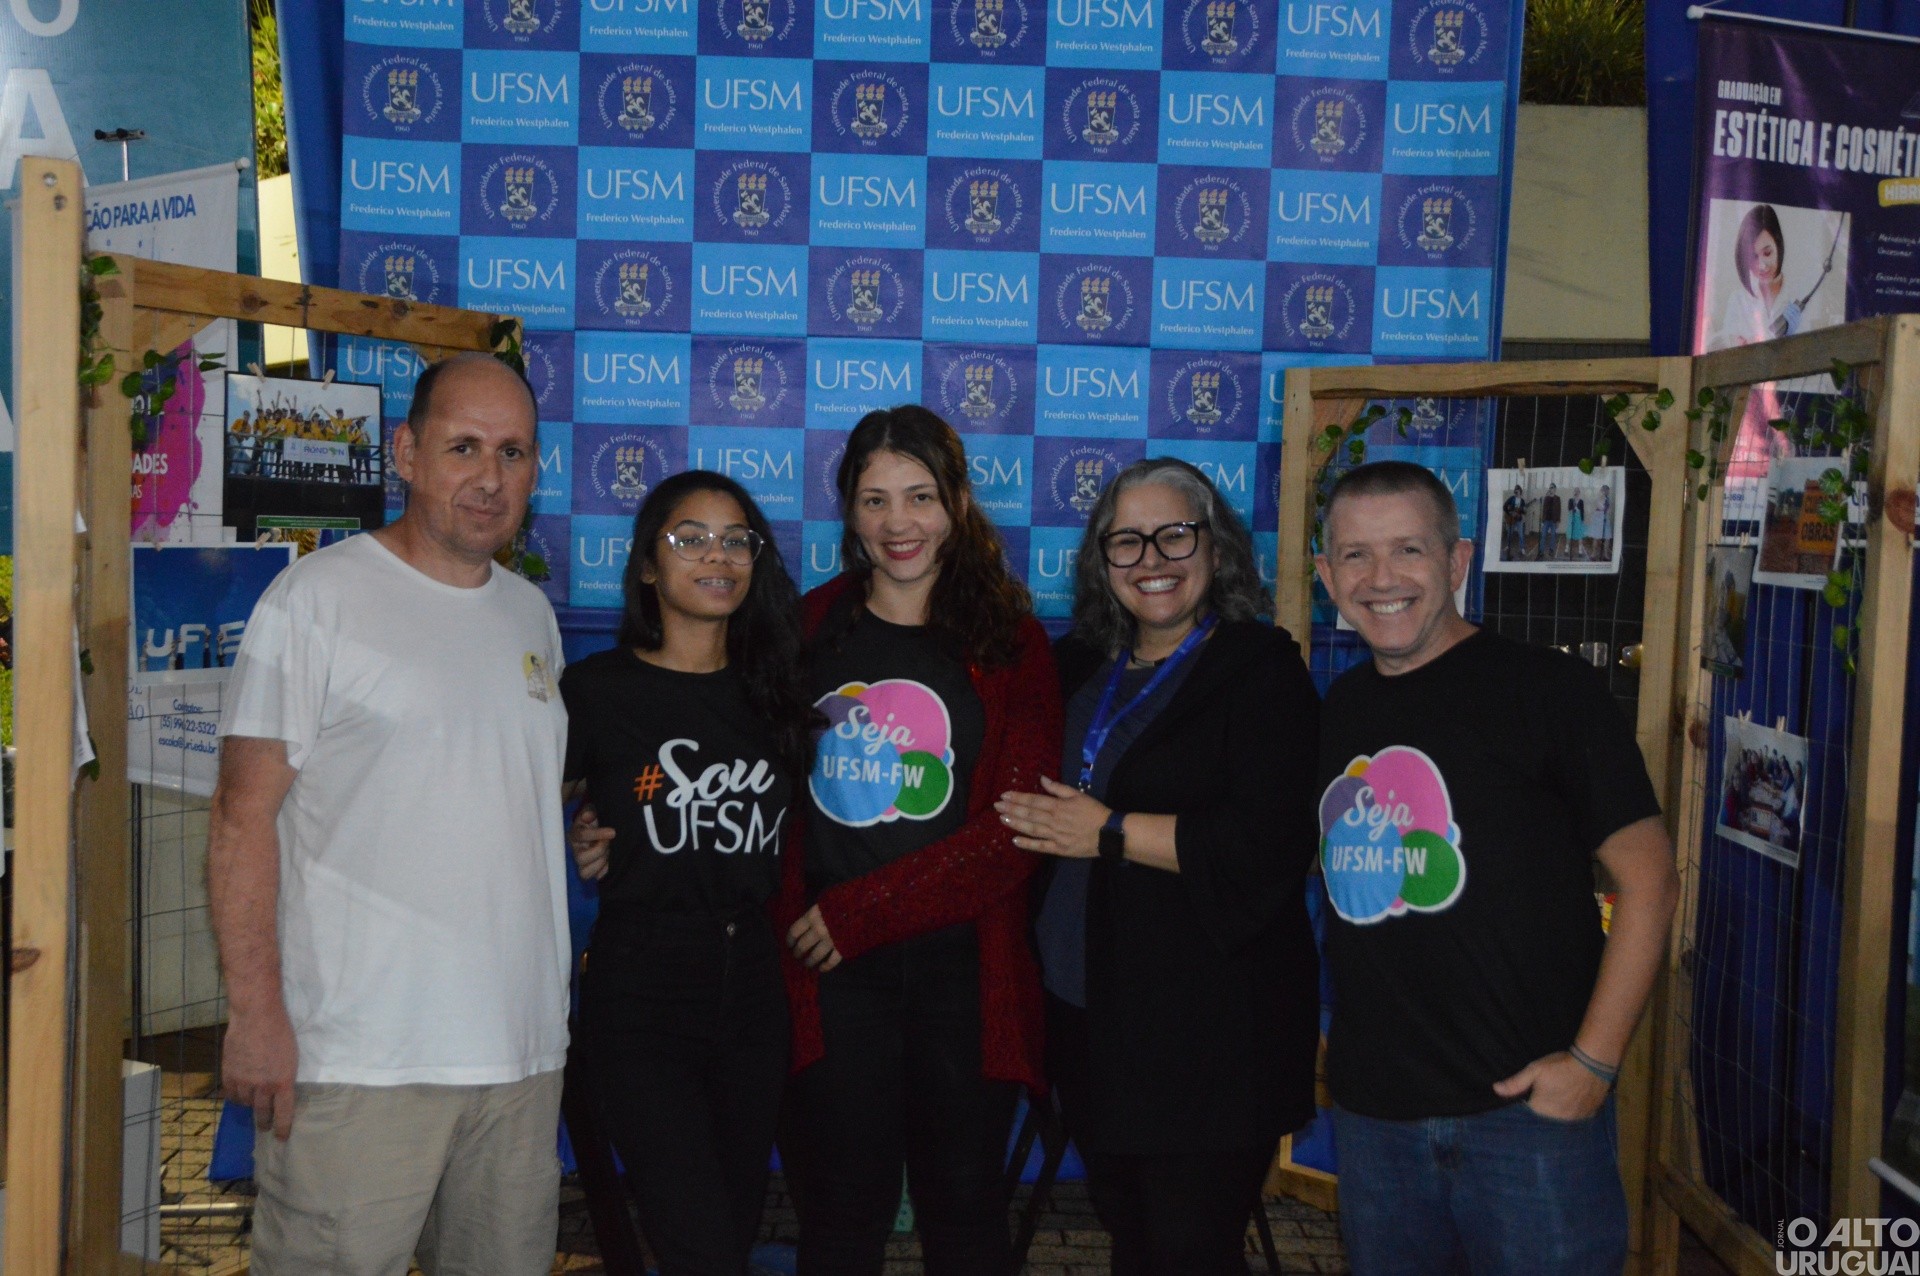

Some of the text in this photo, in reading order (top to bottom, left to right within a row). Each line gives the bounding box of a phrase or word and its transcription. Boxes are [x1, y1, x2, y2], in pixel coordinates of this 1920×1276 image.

[353, 17, 454, 32] Frederico Westphalen
[590, 26, 688, 39] Frederico Westphalen
[1286, 6, 1380, 40] UFSM
[823, 34, 921, 47] Frederico Westphalen
[1056, 41, 1153, 54] Frederico Westphalen
[617, 62, 654, 74] Federal
[1285, 50, 1379, 64] Frederico Westphalen
[471, 71, 569, 104] UFSM
[663, 77, 677, 104] Santa
[705, 79, 802, 112] UFSM
[1083, 77, 1119, 89] Federal
[1718, 79, 1781, 105] GRADUAÇÃO EM
[598, 72, 617, 129] Universidade
[938, 85, 1034, 119] UFSM
[1127, 92, 1141, 119] Santa
[1168, 93, 1264, 127] UFSM
[470, 116, 569, 129] Frederico Westphalen
[658, 106, 677, 130] Maria
[1063, 87, 1082, 143] Universidade
[1394, 103, 1490, 135] UFSM
[705, 123, 802, 136] Frederico Westphalen
[937, 130, 1034, 144] Frederico Westphalen
[1122, 121, 1141, 145] Maria
[1713, 108, 1814, 167] ESTÉTICA
[1818, 122, 1832, 168] E
[1167, 137, 1263, 151] Frederico Westphalen
[1392, 147, 1489, 160] Frederico Westphalen
[351, 159, 450, 193] UFSM
[732, 159, 768, 171] Federal
[587, 168, 684, 201] UFSM
[776, 174, 791, 201] Santa
[819, 175, 916, 209] UFSM
[1194, 174, 1230, 186] Federal
[712, 169, 731, 225] Universidade
[1050, 183, 1146, 215] UFSM
[1238, 190, 1251, 216] Santa
[1278, 191, 1370, 225] UFSM
[114, 201, 150, 228] PARA
[151, 199, 160, 222] A
[162, 194, 196, 220] VIDA
[351, 205, 451, 219] Frederico Westphalen
[586, 213, 684, 226] Frederico Westphalen
[772, 203, 791, 227] Maria
[1174, 184, 1193, 240] Universidade
[818, 220, 916, 233] Frederico Westphalen
[1049, 227, 1146, 240] Frederico Westphalen
[1232, 219, 1251, 243] Maria
[1276, 235, 1369, 249] Frederico Westphalen
[467, 257, 566, 289] UFSM
[846, 256, 883, 268] Federal
[701, 264, 798, 297] UFSM
[826, 265, 845, 321] Universidade
[891, 271, 905, 297] Santa
[932, 272, 1029, 304] UFSM
[1161, 279, 1255, 311] UFSM
[1383, 287, 1479, 319] UFSM
[511, 303, 566, 315] Westphalen
[700, 308, 798, 321] Frederico Westphalen
[886, 299, 905, 323] Maria
[932, 315, 1029, 328] Frederico Westphalen
[1160, 323, 1254, 336] Frederico Westphalen
[1382, 331, 1478, 343] Frederico Westphalen
[727, 344, 764, 356] Federal
[583, 353, 680, 385] UFSM
[708, 354, 727, 409] Universidade
[773, 359, 787, 385] Santa
[815, 360, 911, 392] UFSM
[1045, 366, 1139, 398] UFSM
[582, 396, 680, 409] Frederico Westphalen
[768, 388, 787, 411] Maria
[814, 404, 856, 414] Frederico
[1044, 410, 1139, 423] Frederico Westphalen
[965, 455, 1022, 486] SM
[835, 705, 915, 755] Seja
[633, 738, 775, 808] #Sou
[822, 754, 925, 789] UFSM-FW
[1343, 785, 1414, 842] Seja
[643, 799, 787, 857] UFSM
[1331, 843, 1428, 876] UFSM-FW
